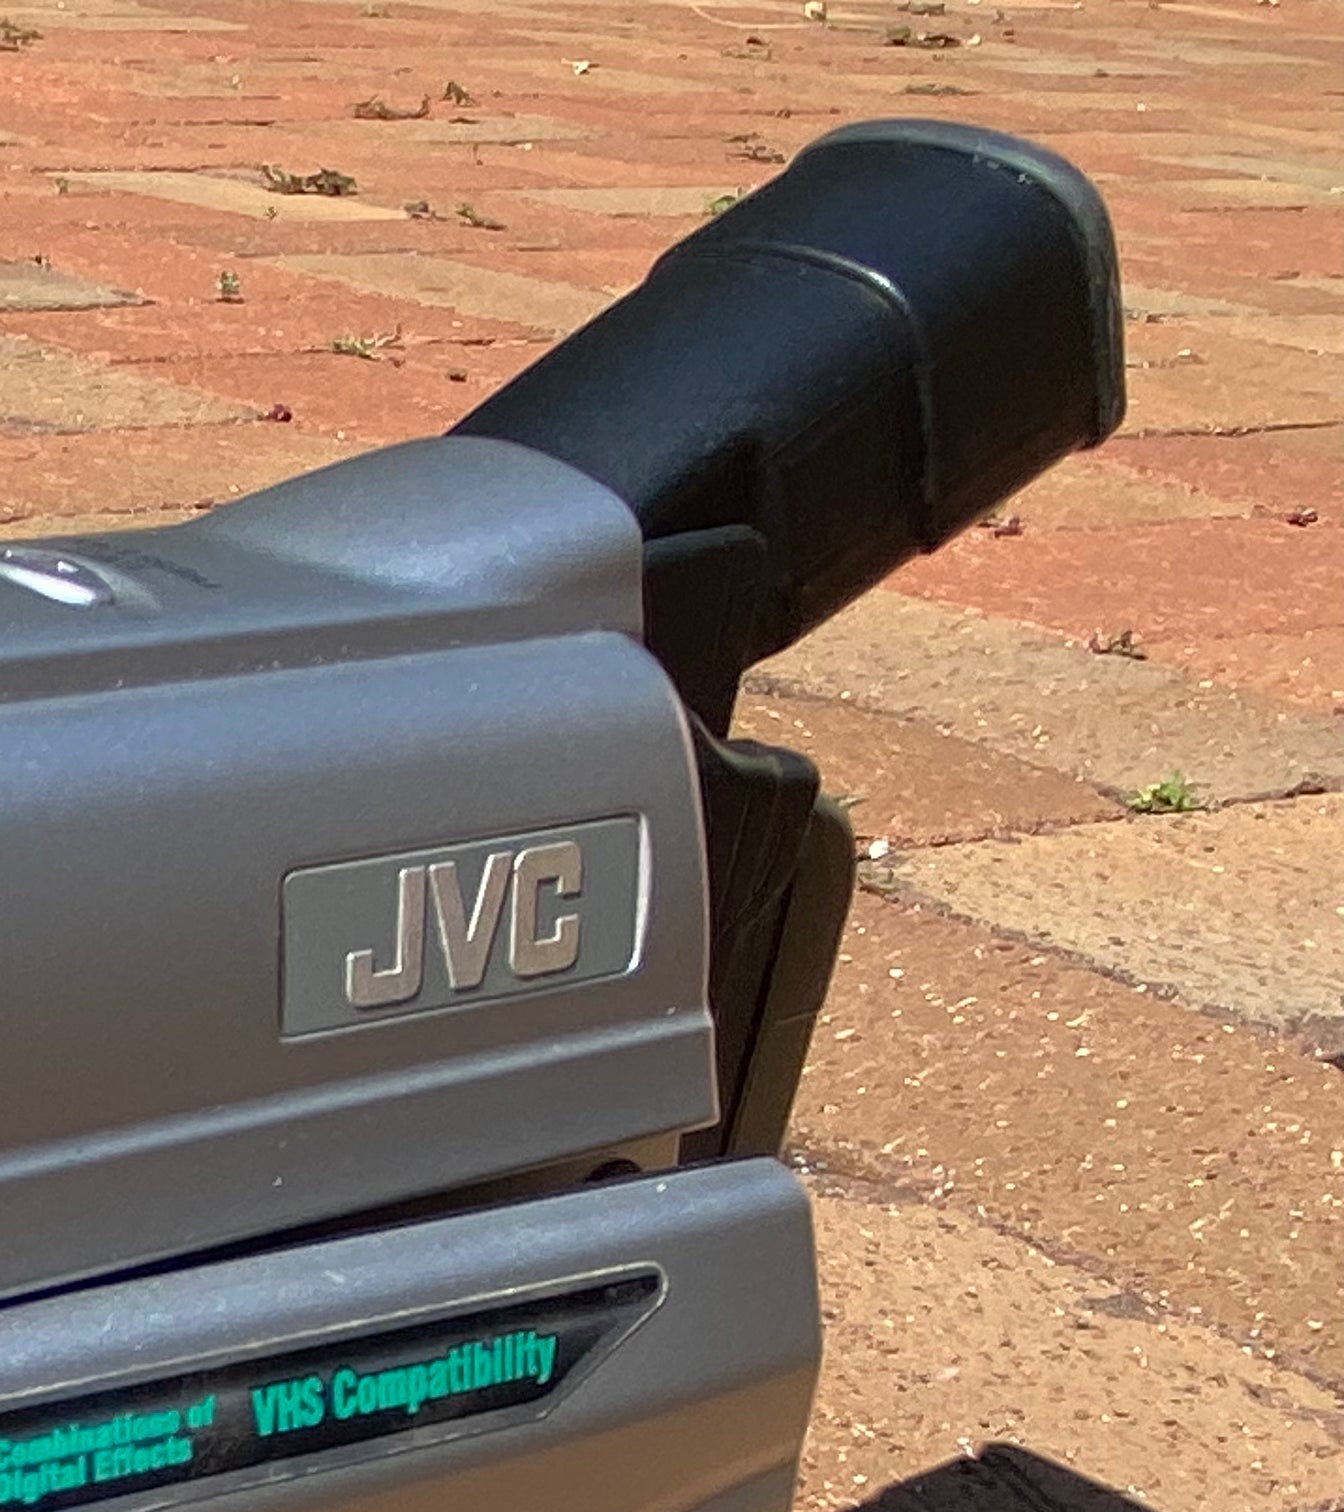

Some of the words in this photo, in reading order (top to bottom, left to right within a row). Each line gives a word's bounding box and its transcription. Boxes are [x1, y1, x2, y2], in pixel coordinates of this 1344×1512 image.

[346, 840, 582, 1010] JVC
[187, 1395, 217, 1430] of
[250, 1376, 327, 1438] VHS
[331, 1329, 559, 1420] Compatibility
[92, 1436, 196, 1483] Effects
